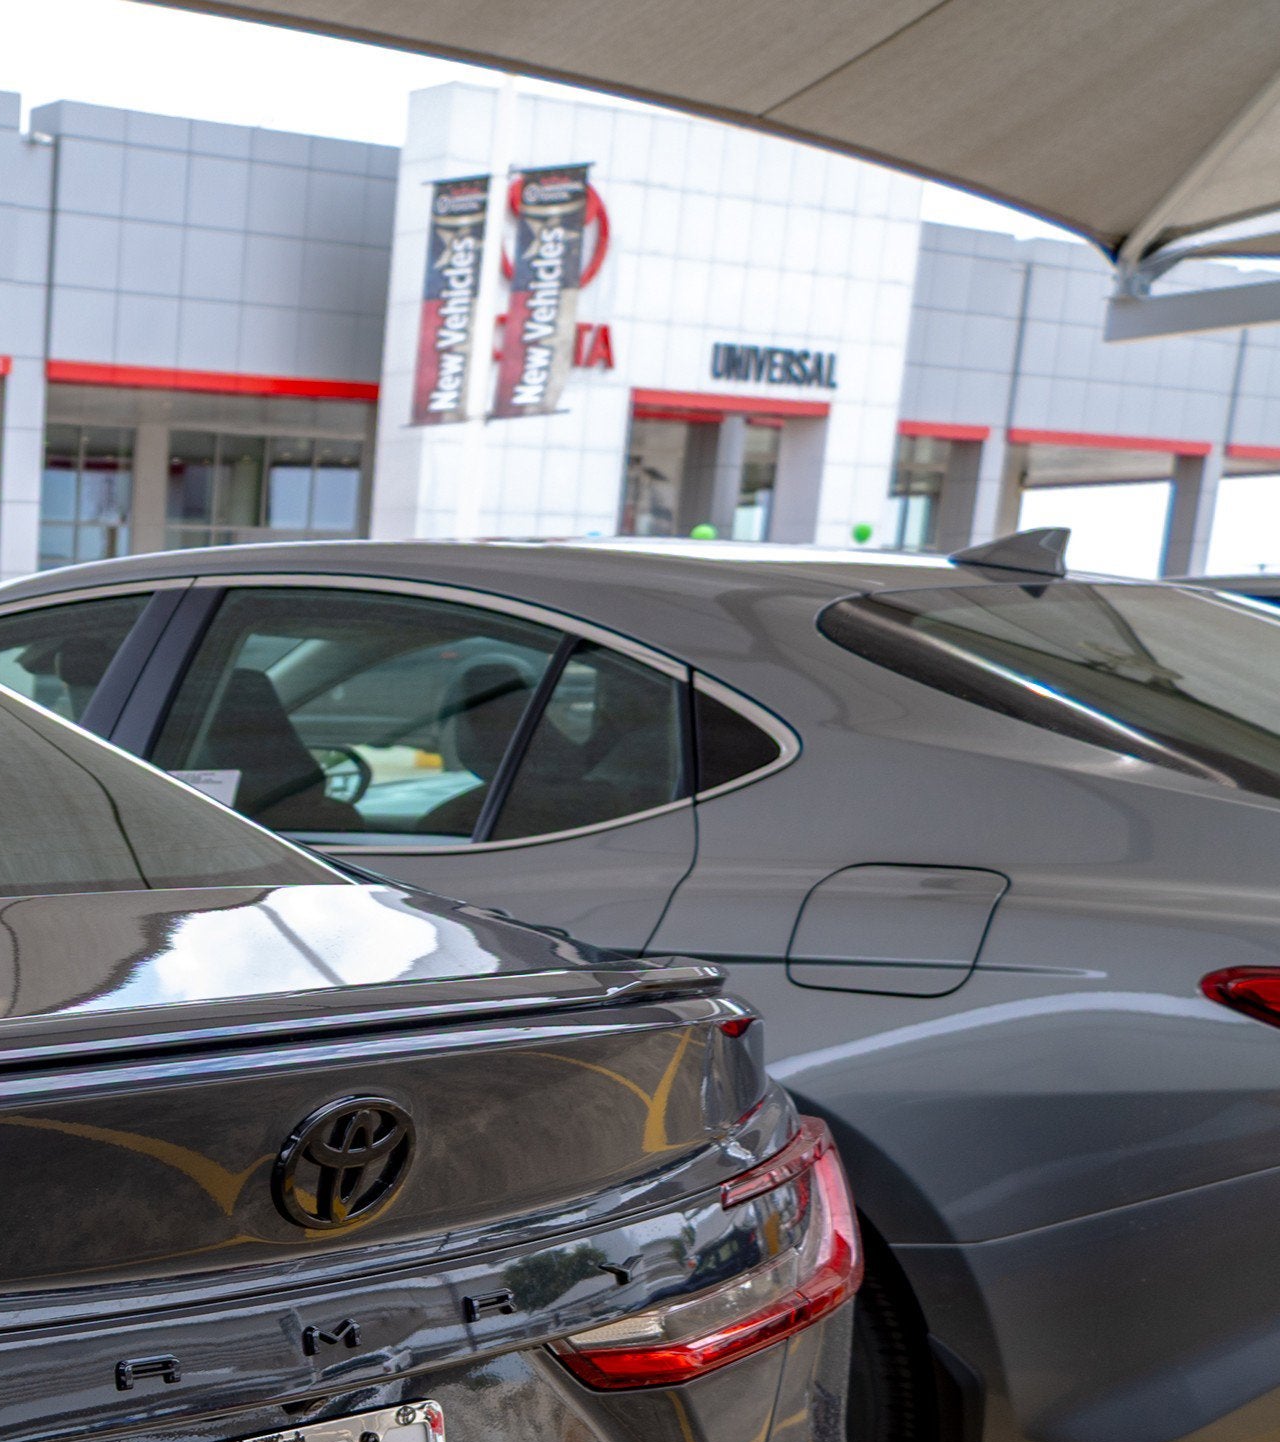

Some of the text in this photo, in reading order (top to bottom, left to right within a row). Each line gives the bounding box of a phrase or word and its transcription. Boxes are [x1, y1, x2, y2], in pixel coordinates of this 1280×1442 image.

[435, 236, 476, 350] Vehicles
[521, 226, 566, 343] Vehicles
[427, 353, 464, 412] New
[511, 345, 552, 405] New
[711, 342, 837, 388] UNIVERSAL
